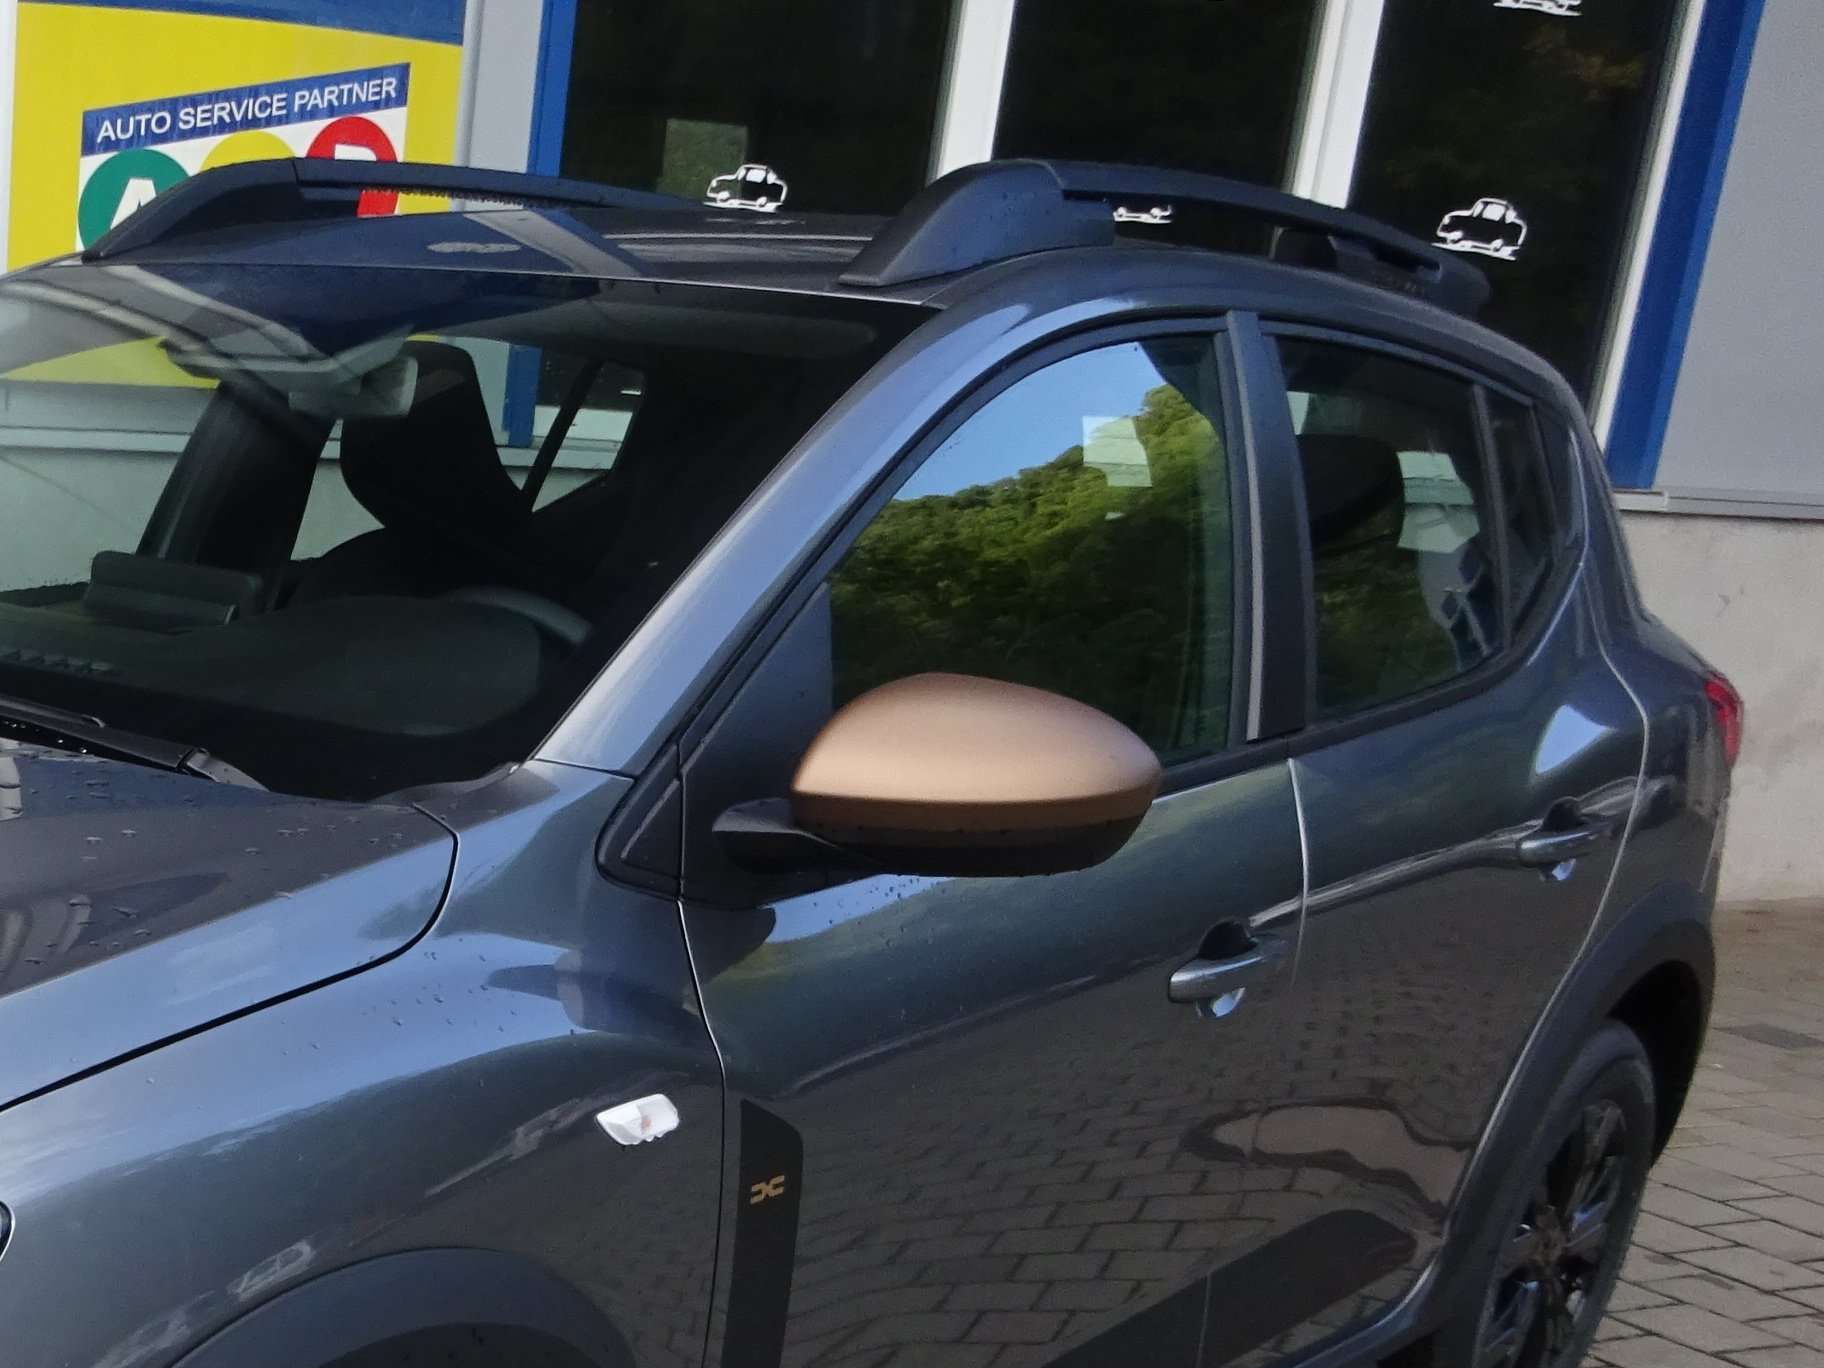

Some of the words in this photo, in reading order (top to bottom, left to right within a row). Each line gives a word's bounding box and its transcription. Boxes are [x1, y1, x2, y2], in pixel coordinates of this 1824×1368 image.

[96, 110, 172, 143] AUTO
[178, 93, 289, 130] SERVICE
[294, 77, 397, 113] PARTNER
